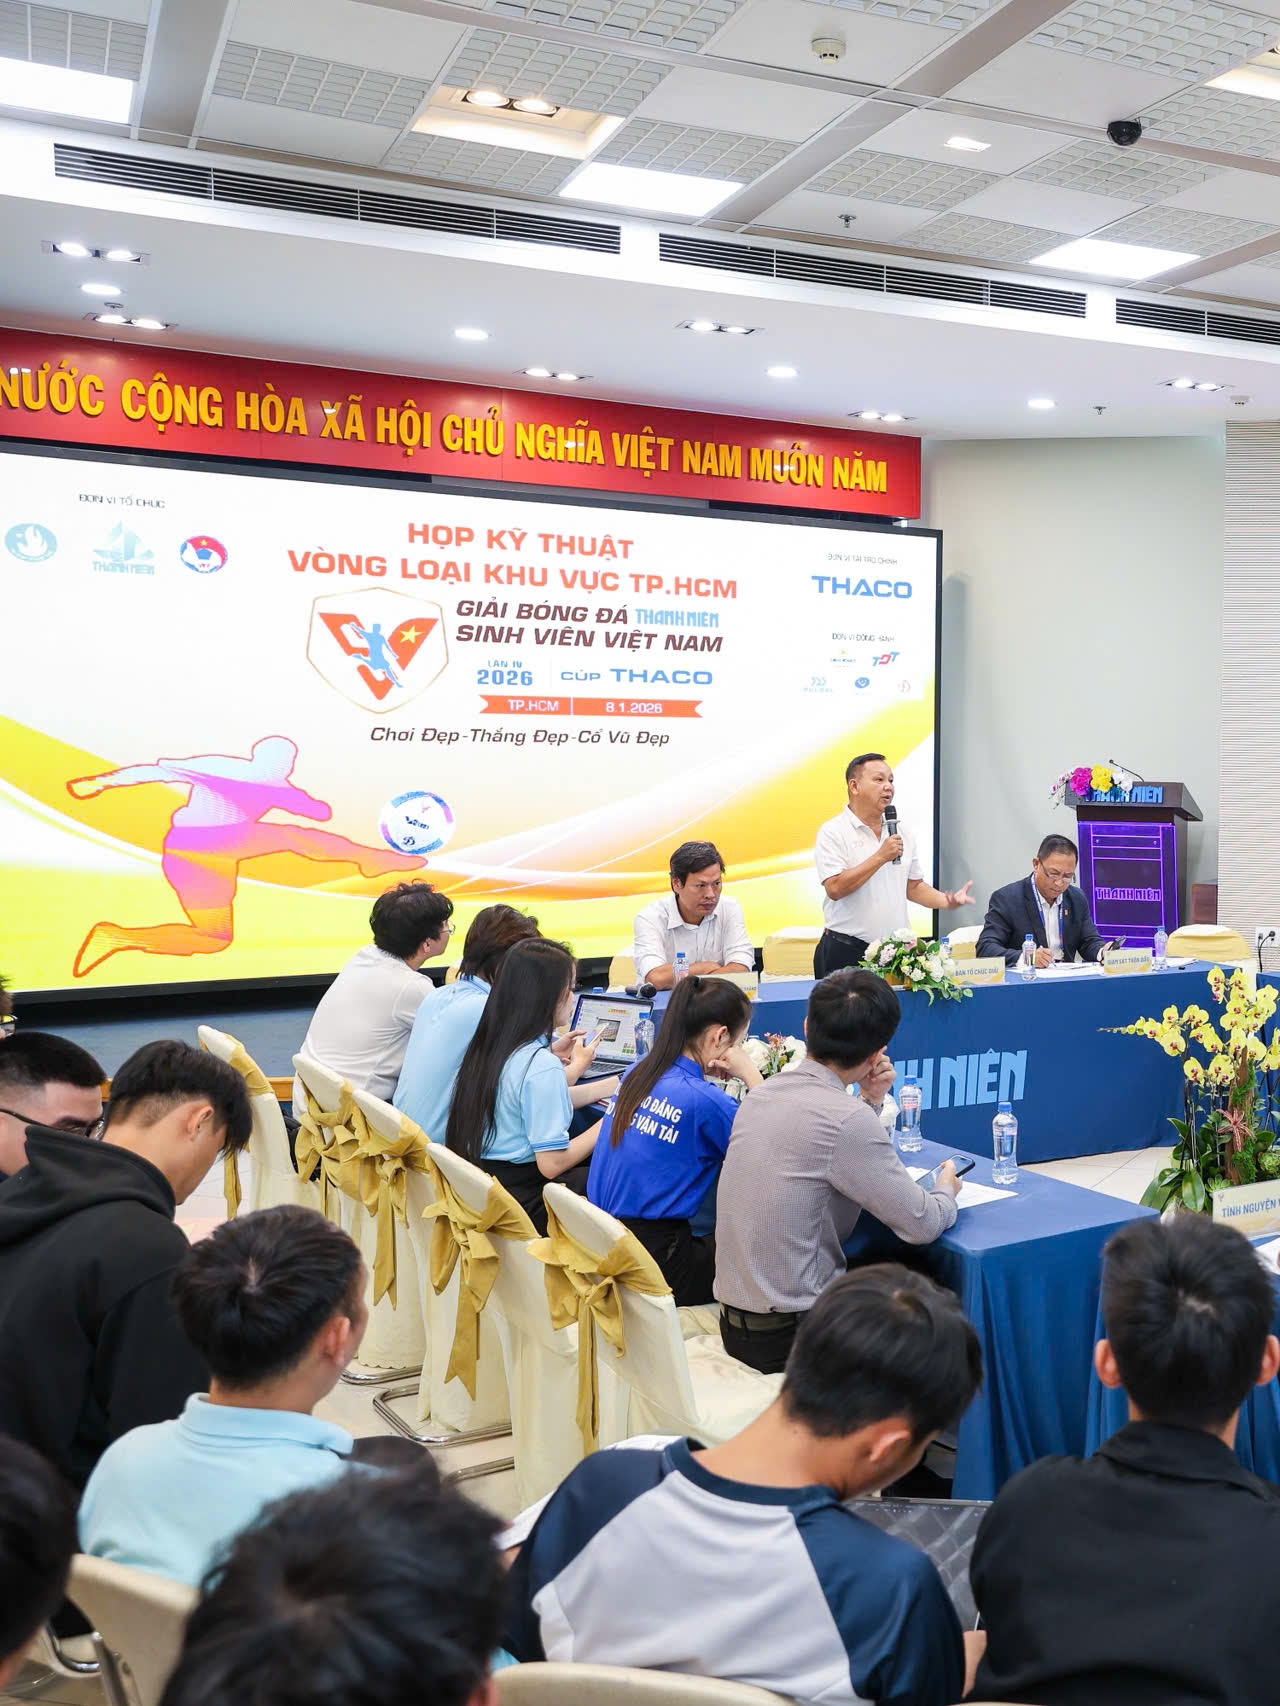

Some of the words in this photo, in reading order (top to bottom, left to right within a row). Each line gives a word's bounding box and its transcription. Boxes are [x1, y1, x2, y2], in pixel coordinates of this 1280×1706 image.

[0, 359, 104, 416] NƯỚC
[121, 371, 223, 432] CỘNG
[235, 382, 308, 436] HÒA
[320, 394, 366, 442] XÃ
[376, 399, 432, 456] HỘI
[441, 404, 504, 456] CHỦ
[515, 419, 605, 465] NGHĨA
[611, 425, 674, 478] VIỆT
[682, 440, 741, 478] NAM
[750, 442, 824, 487] MUÔN
[832, 450, 888, 494] NĂM
[408, 522, 474, 550] HỌP
[487, 527, 527, 551] KỸ
[538, 532, 634, 560] THUẬT
[287, 546, 387, 577] VÒNG
[401, 558, 471, 585] LOẠI
[484, 563, 548, 587] KHU
[559, 568, 619, 594] VỰC
[629, 573, 737, 599] TP.HCM
[811, 575, 913, 599] THACO
[456, 596, 508, 618] GIẢI
[516, 600, 588, 622] BÓNG
[595, 604, 628, 624] ĐÁ
[455, 624, 524, 644] SINH
[534, 625, 595, 647] VIÊN
[604, 629, 657, 652] VIỆT
[664, 634, 724, 652] NAM
[477, 669, 533, 686] 2026
[560, 668, 601, 681] CÚP
[610, 668, 713, 685] THACO
[508, 699, 559, 711] TP.HCM
[605, 702, 663, 714] 8.1.2026
[370, 727, 415, 742] Chơi
[609, 730, 630, 744] Vũ
[635, 730, 670, 747] Đẹp
[1095, 886, 1135, 901] THANH
[938, 1047, 1028, 1109] NIÊN
[649, 1096, 683, 1123] ĐẲNG
[636, 1115, 659, 1136] VẬN
[658, 1124, 680, 1145] TẢI
[1243, 1198, 1276, 1215] NGUYỆN
